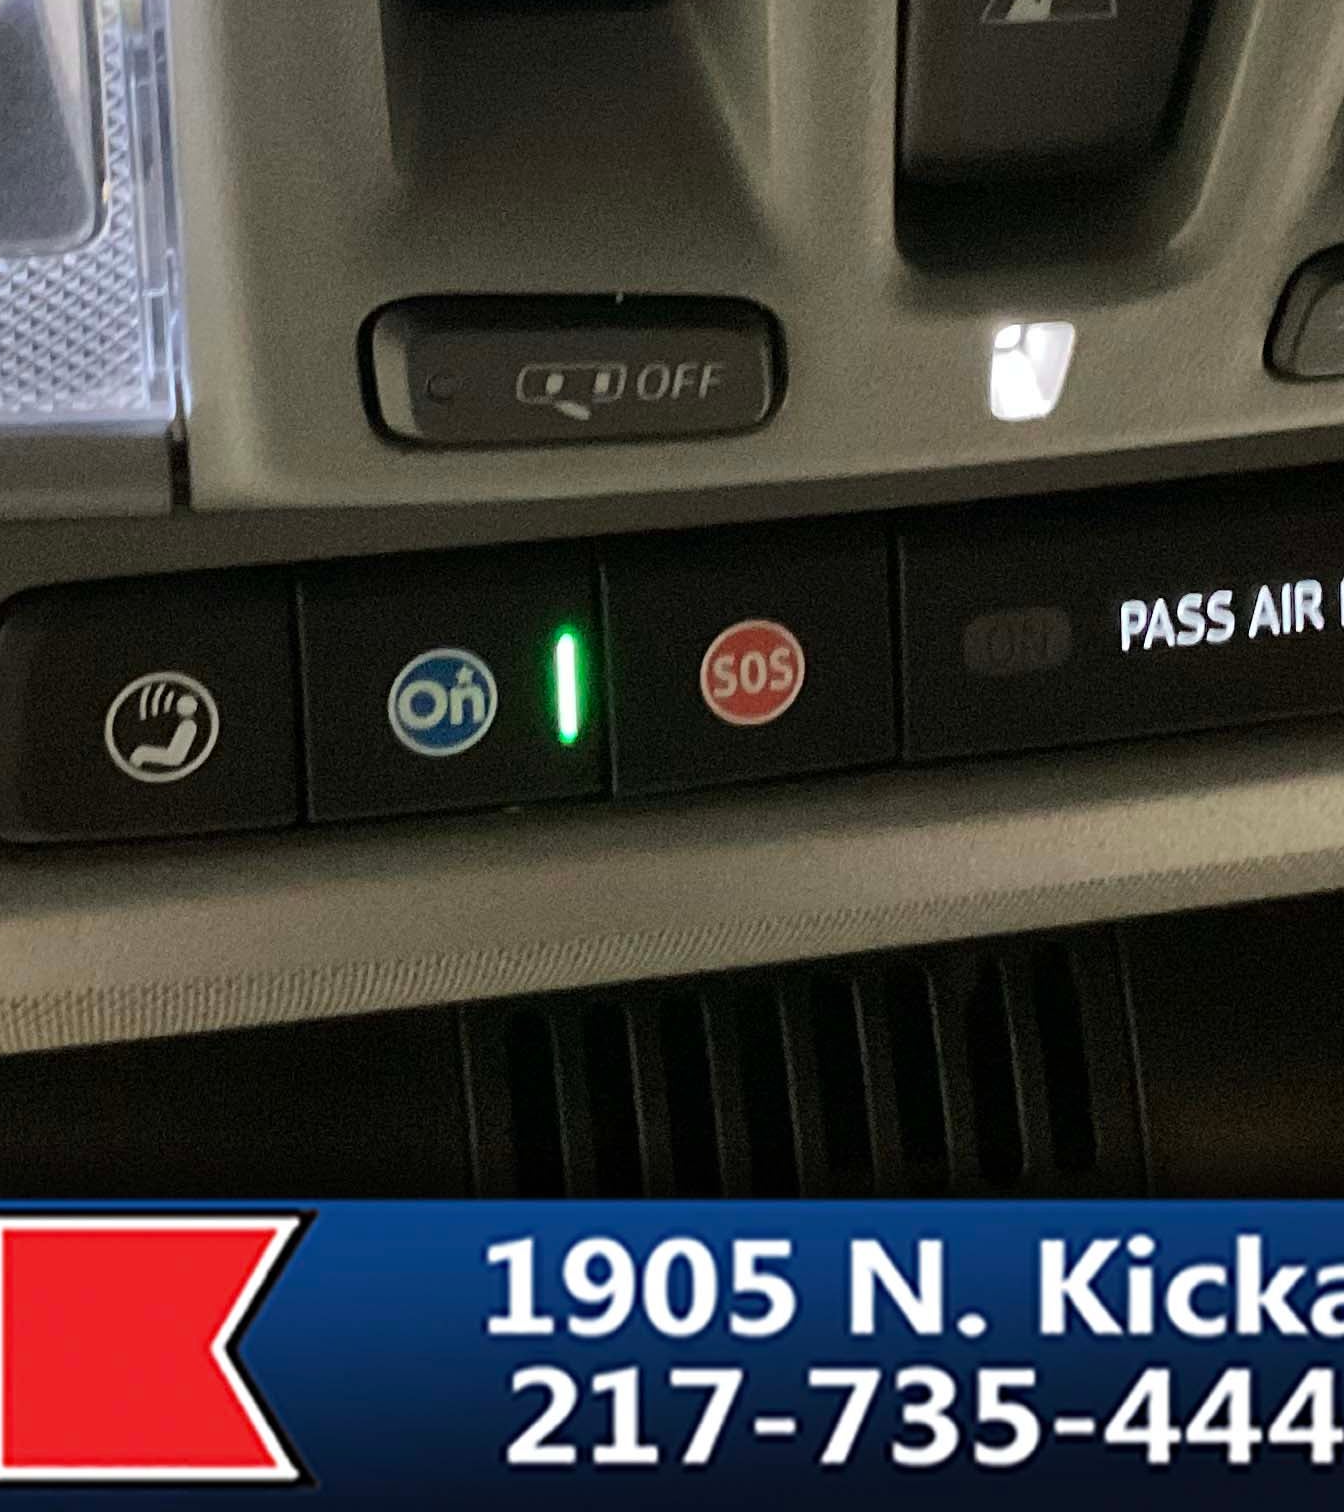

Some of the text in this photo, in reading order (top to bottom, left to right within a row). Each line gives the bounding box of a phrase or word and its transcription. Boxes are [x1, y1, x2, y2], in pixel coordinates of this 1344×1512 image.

[636, 361, 726, 402] OFF
[1120, 589, 1235, 652] PASS
[1248, 578, 1325, 639] AIR
[713, 647, 794, 699] SOS
